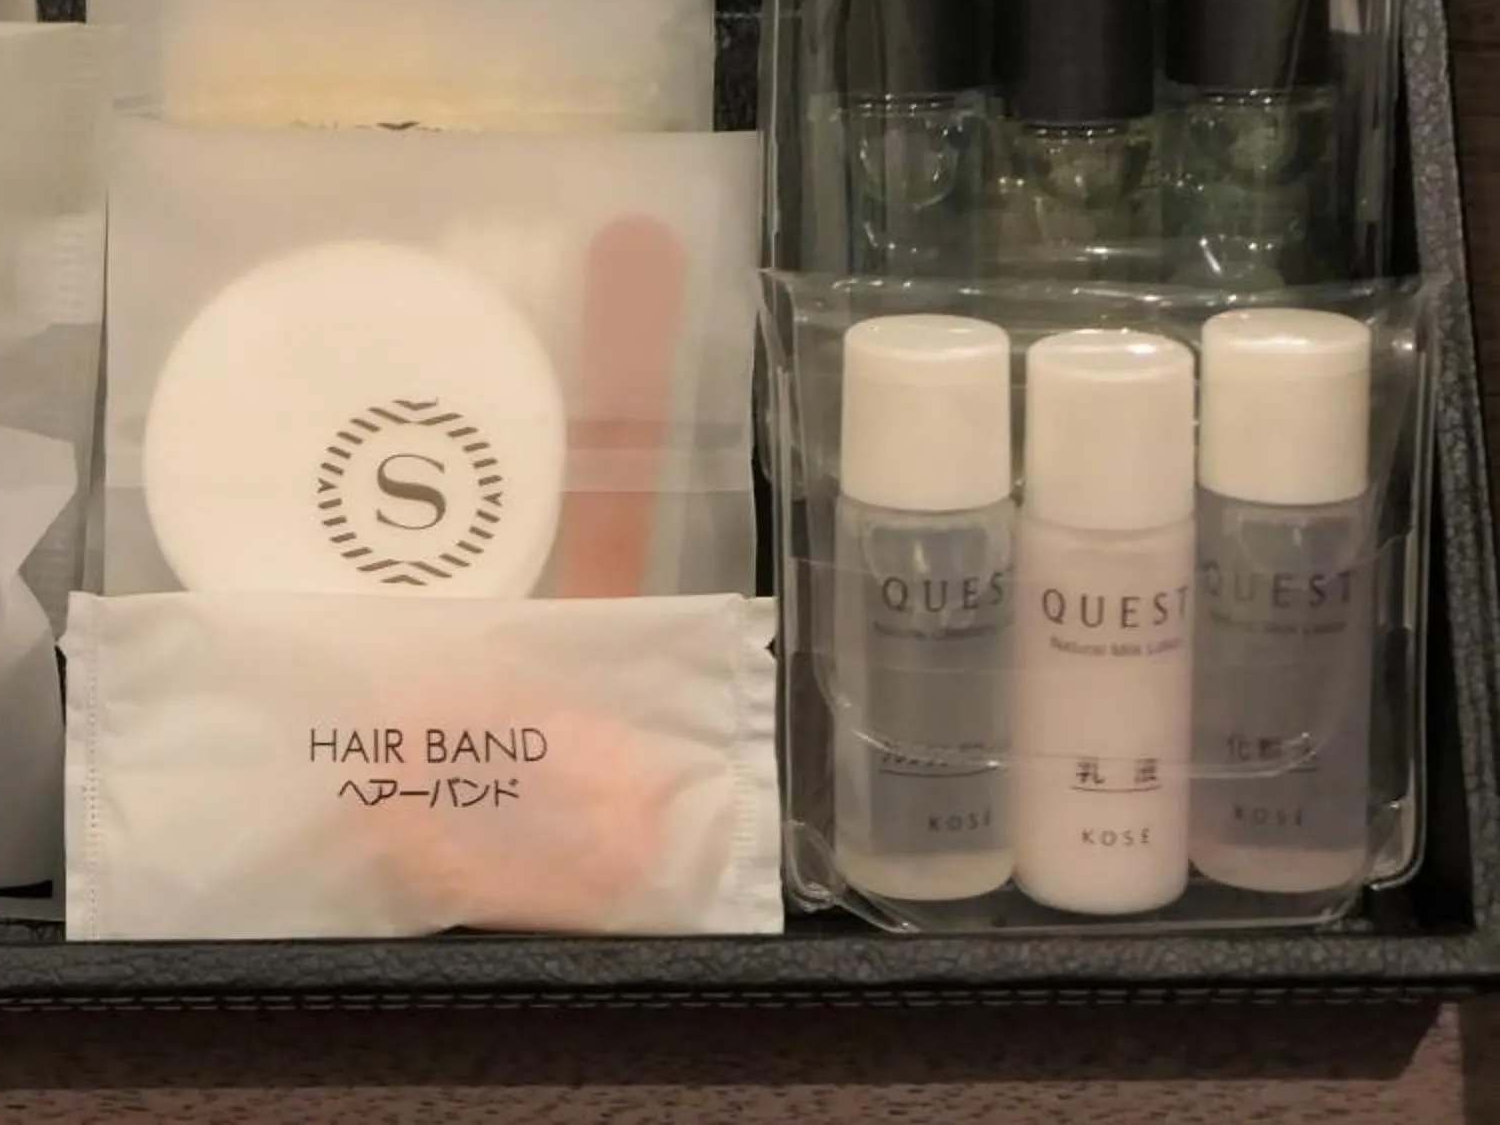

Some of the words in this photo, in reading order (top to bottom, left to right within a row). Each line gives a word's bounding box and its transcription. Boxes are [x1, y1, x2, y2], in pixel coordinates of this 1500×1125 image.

[376, 452, 447, 531] S
[882, 571, 1004, 613] QUES
[1042, 584, 1189, 628] QUEST
[310, 728, 404, 764] HAIR
[427, 727, 548, 764] BAND
[338, 777, 520, 808] ヘアーバンド
